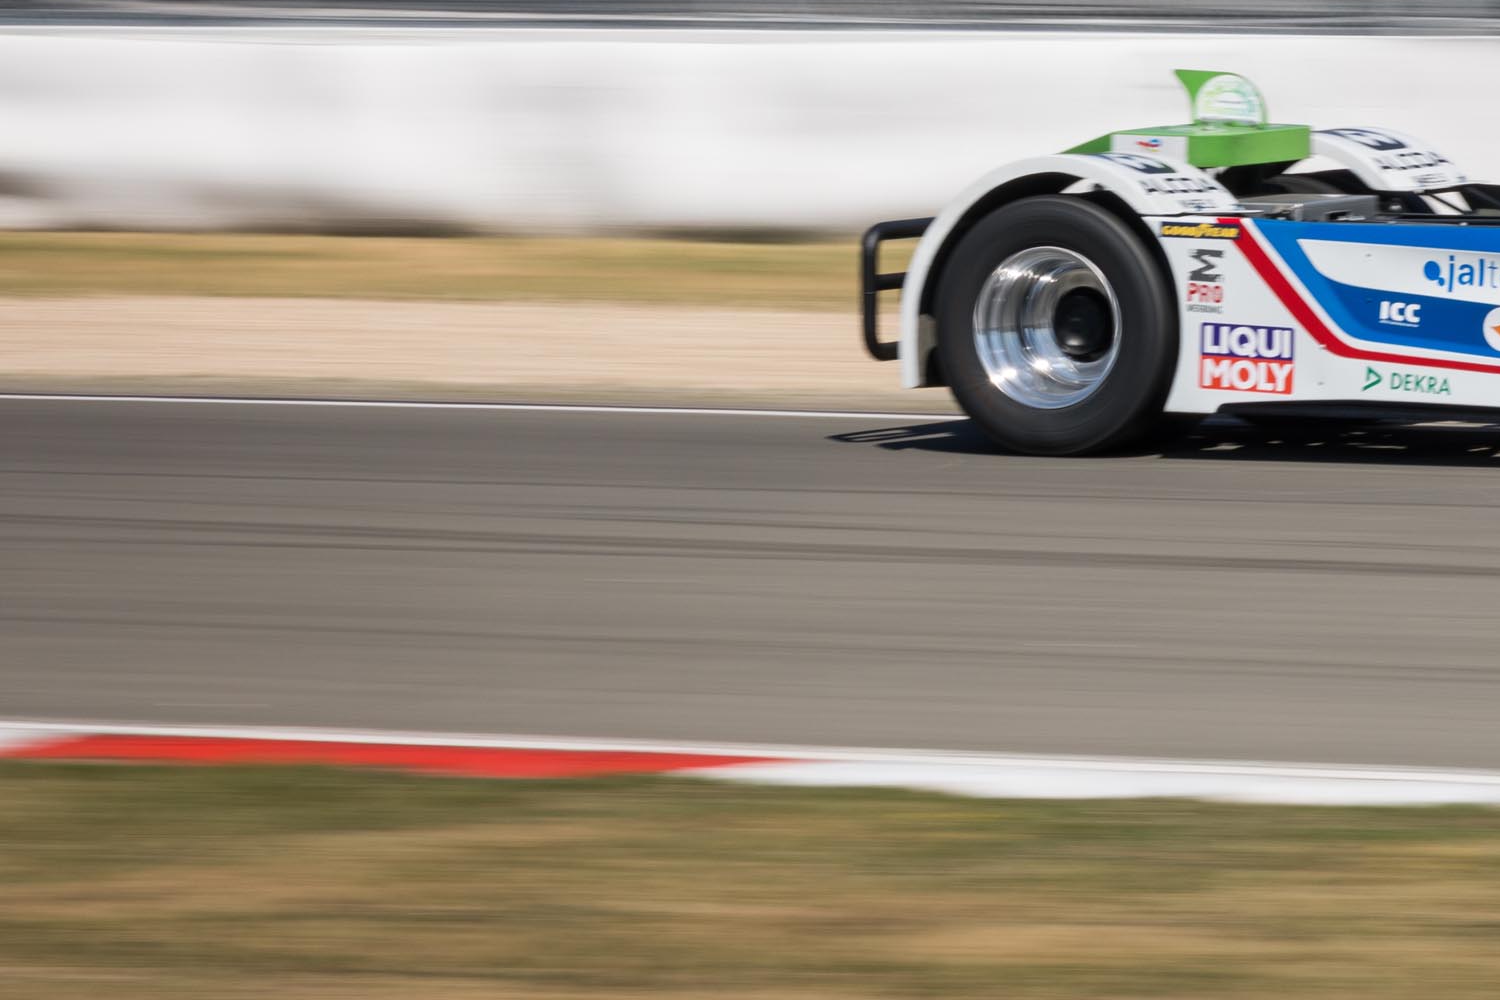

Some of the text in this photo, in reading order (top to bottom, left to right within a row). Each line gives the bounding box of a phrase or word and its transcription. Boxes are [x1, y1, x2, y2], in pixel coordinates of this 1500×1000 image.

[1379, 301, 1421, 324] ICC
[1202, 325, 1292, 358] LIQUI
[1202, 358, 1294, 392] MOLY
[1390, 372, 1451, 395] DEKRA
